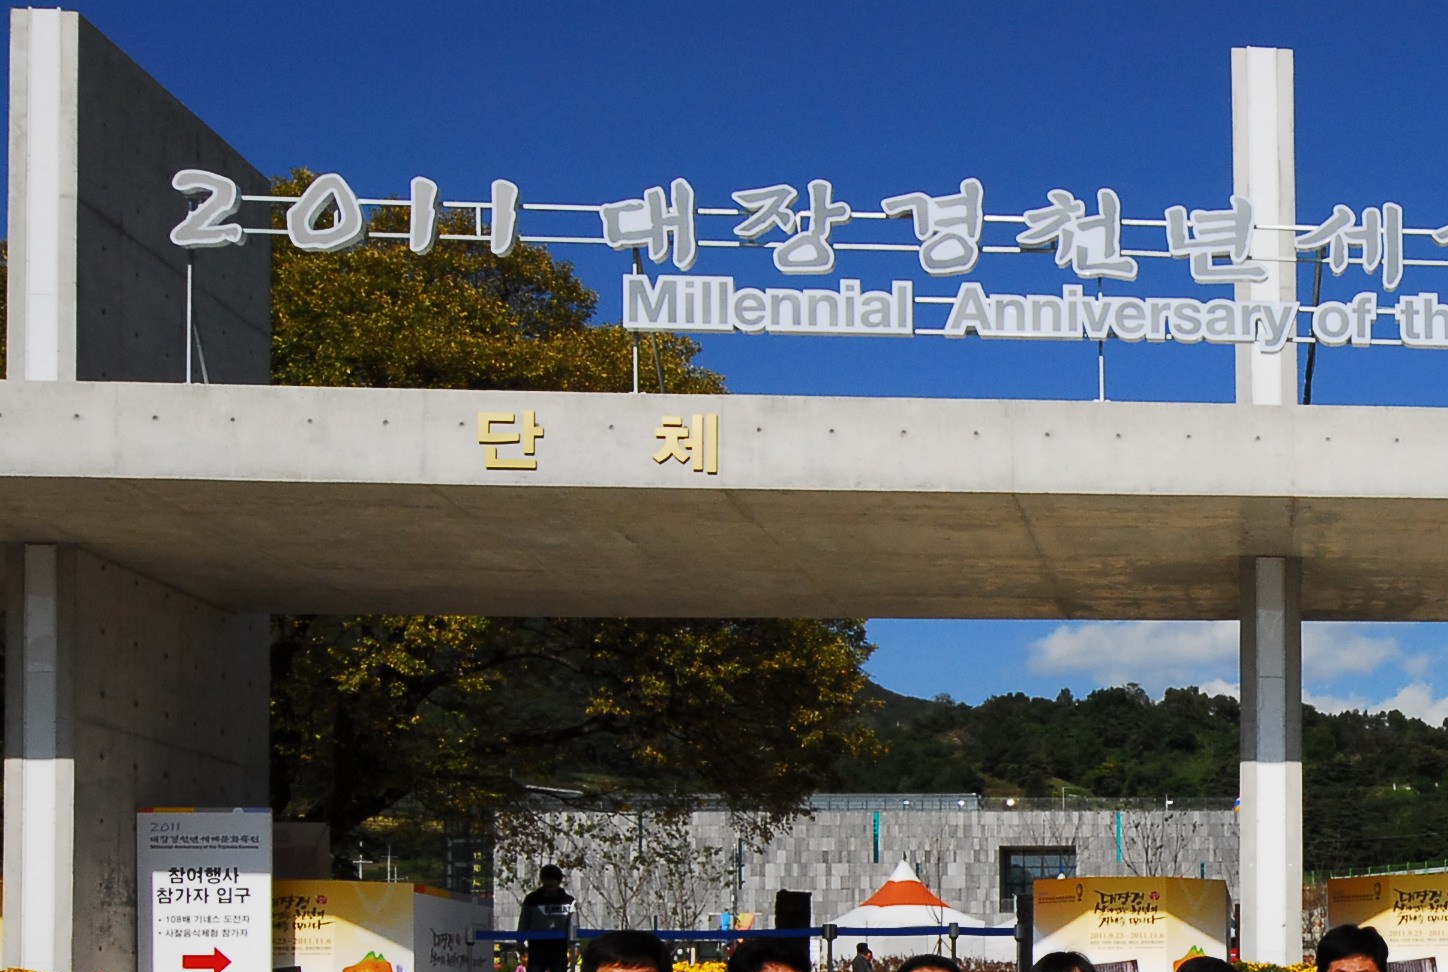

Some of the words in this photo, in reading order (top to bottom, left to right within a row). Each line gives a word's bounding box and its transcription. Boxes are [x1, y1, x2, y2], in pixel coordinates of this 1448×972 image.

[170, 169, 518, 257] 2011
[623, 274, 913, 336] Millennial
[945, 282, 1299, 353] Anniversary
[1313, 292, 1377, 346] of
[150, 822, 182, 832] 2011
[168, 867, 240, 884] 참여행사
[157, 887, 210, 904] 참가자
[217, 887, 251, 904] 입구
[193, 915, 221, 924] 기네스
[223, 915, 251, 924] 도전자
